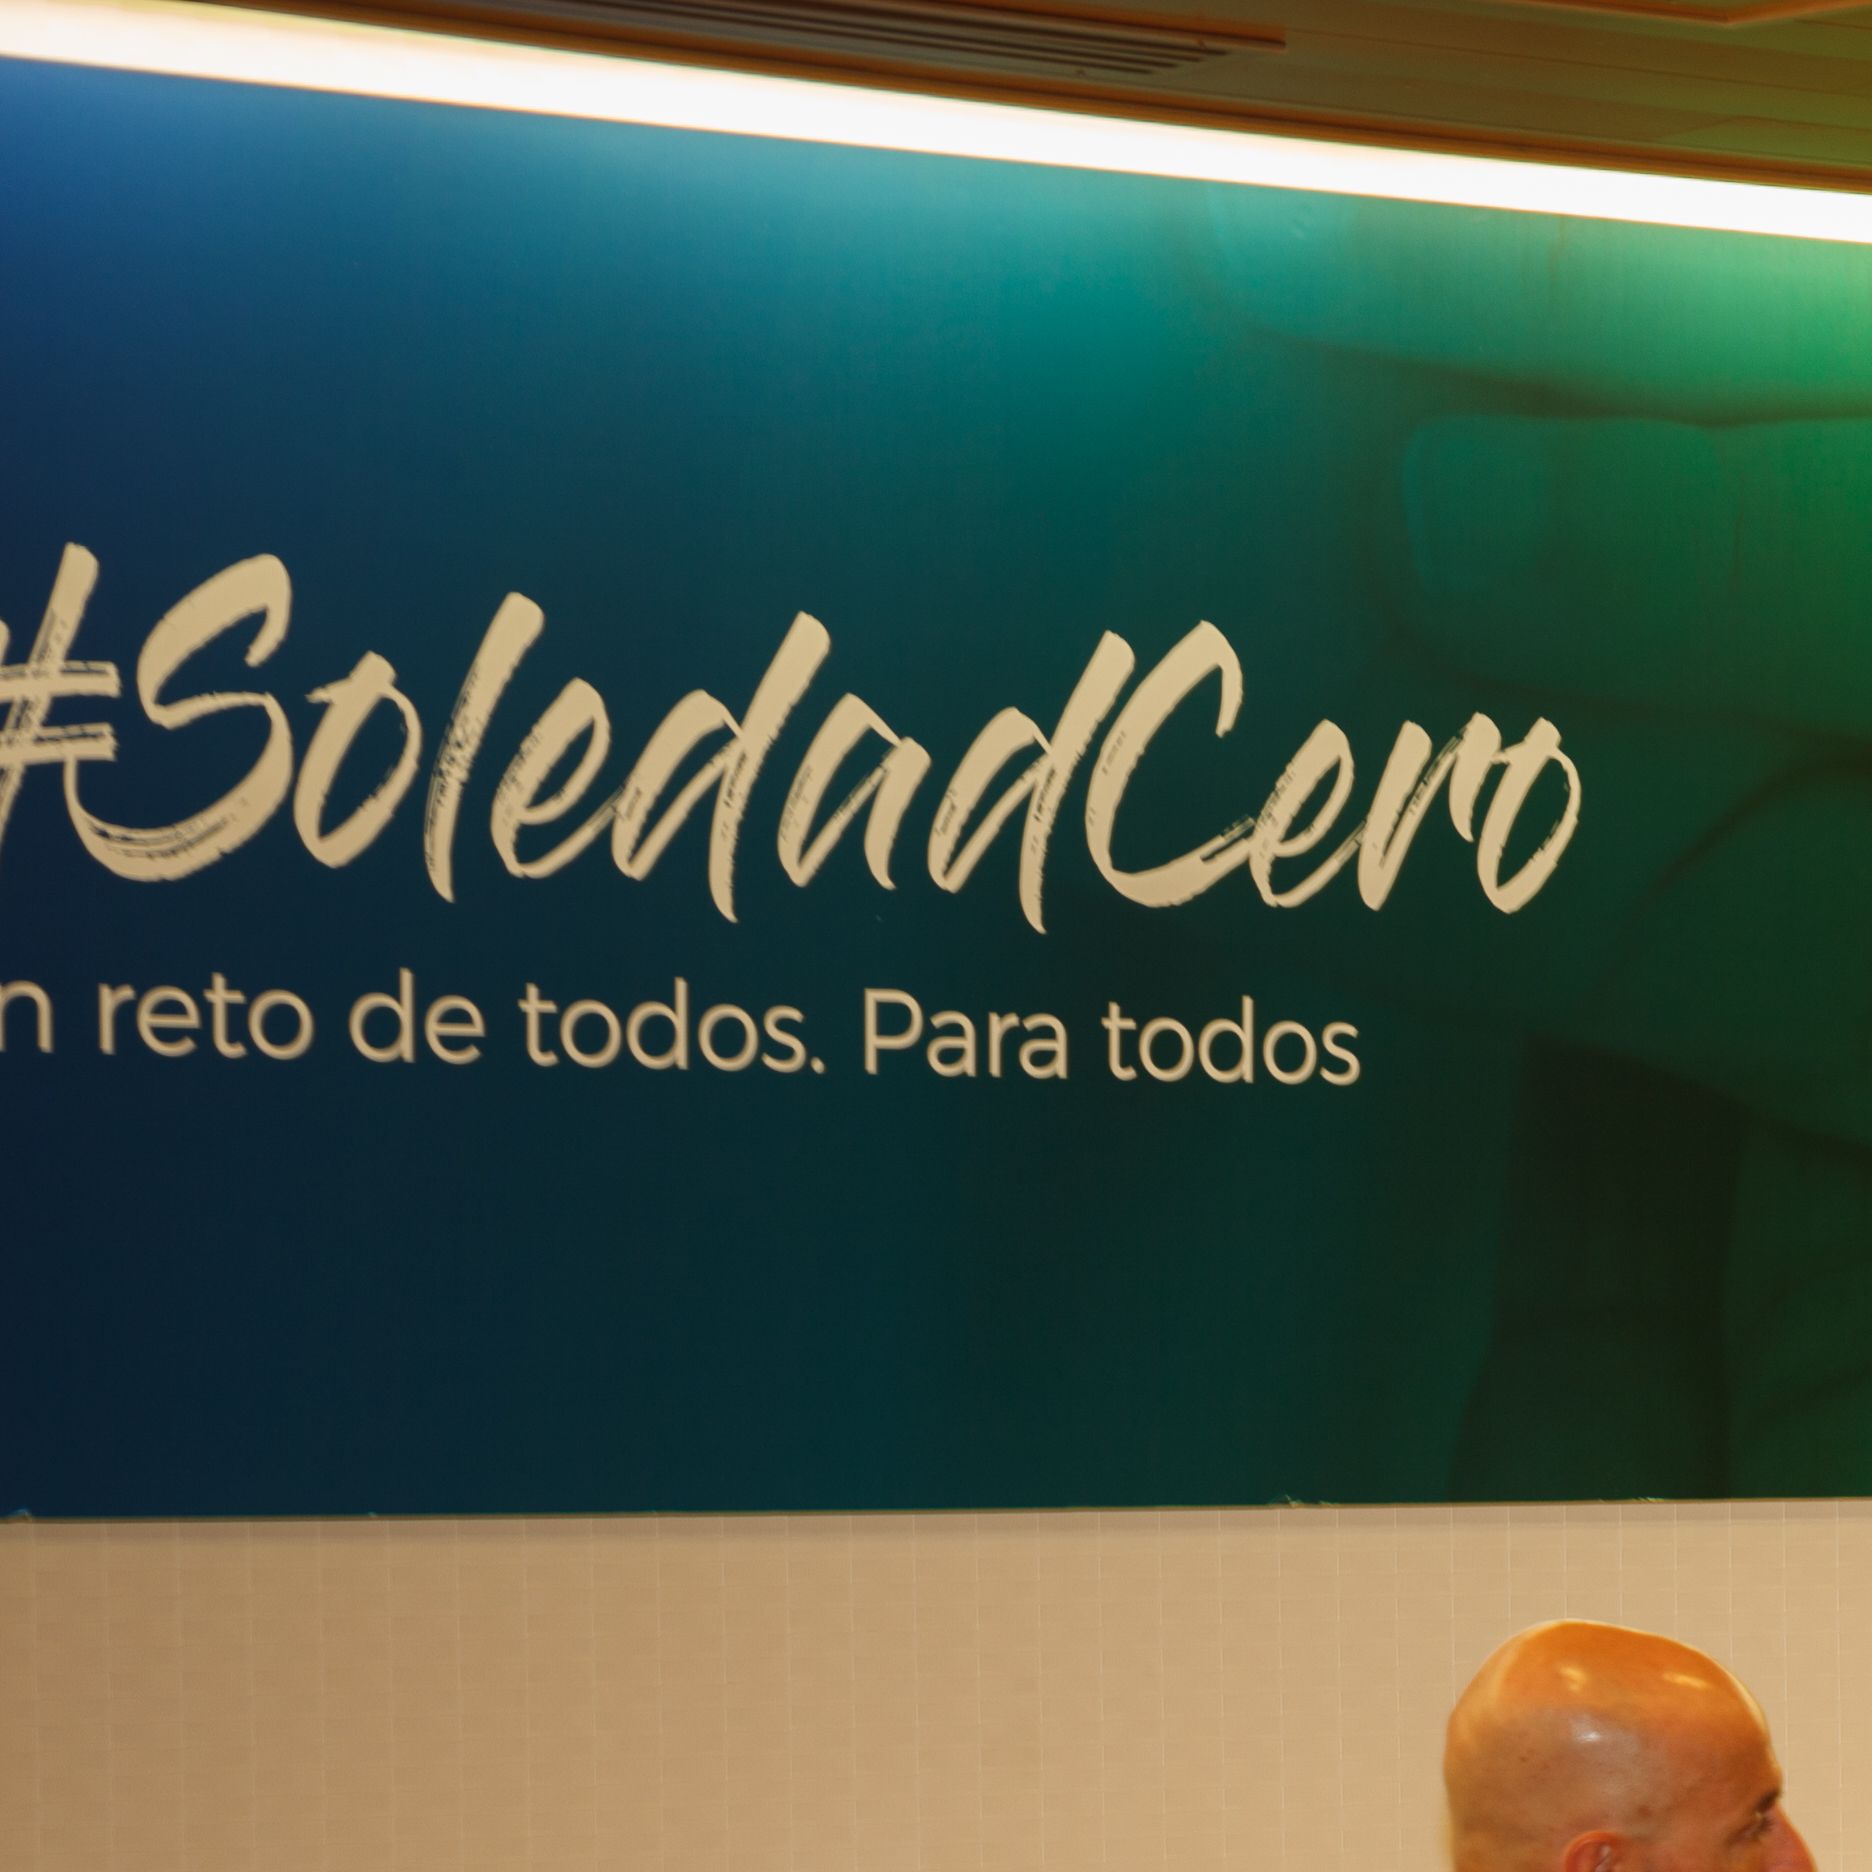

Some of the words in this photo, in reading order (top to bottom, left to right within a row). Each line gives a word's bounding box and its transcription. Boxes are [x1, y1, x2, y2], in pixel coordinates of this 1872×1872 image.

[0, 542, 1582, 934] #SoledadCero
[0, 979, 53, 1053] n
[99, 973, 313, 1060] reto
[349, 968, 486, 1064] de
[518, 977, 826, 1074] todos.
[864, 988, 1069, 1079] Para
[1101, 995, 1362, 1086] todos
